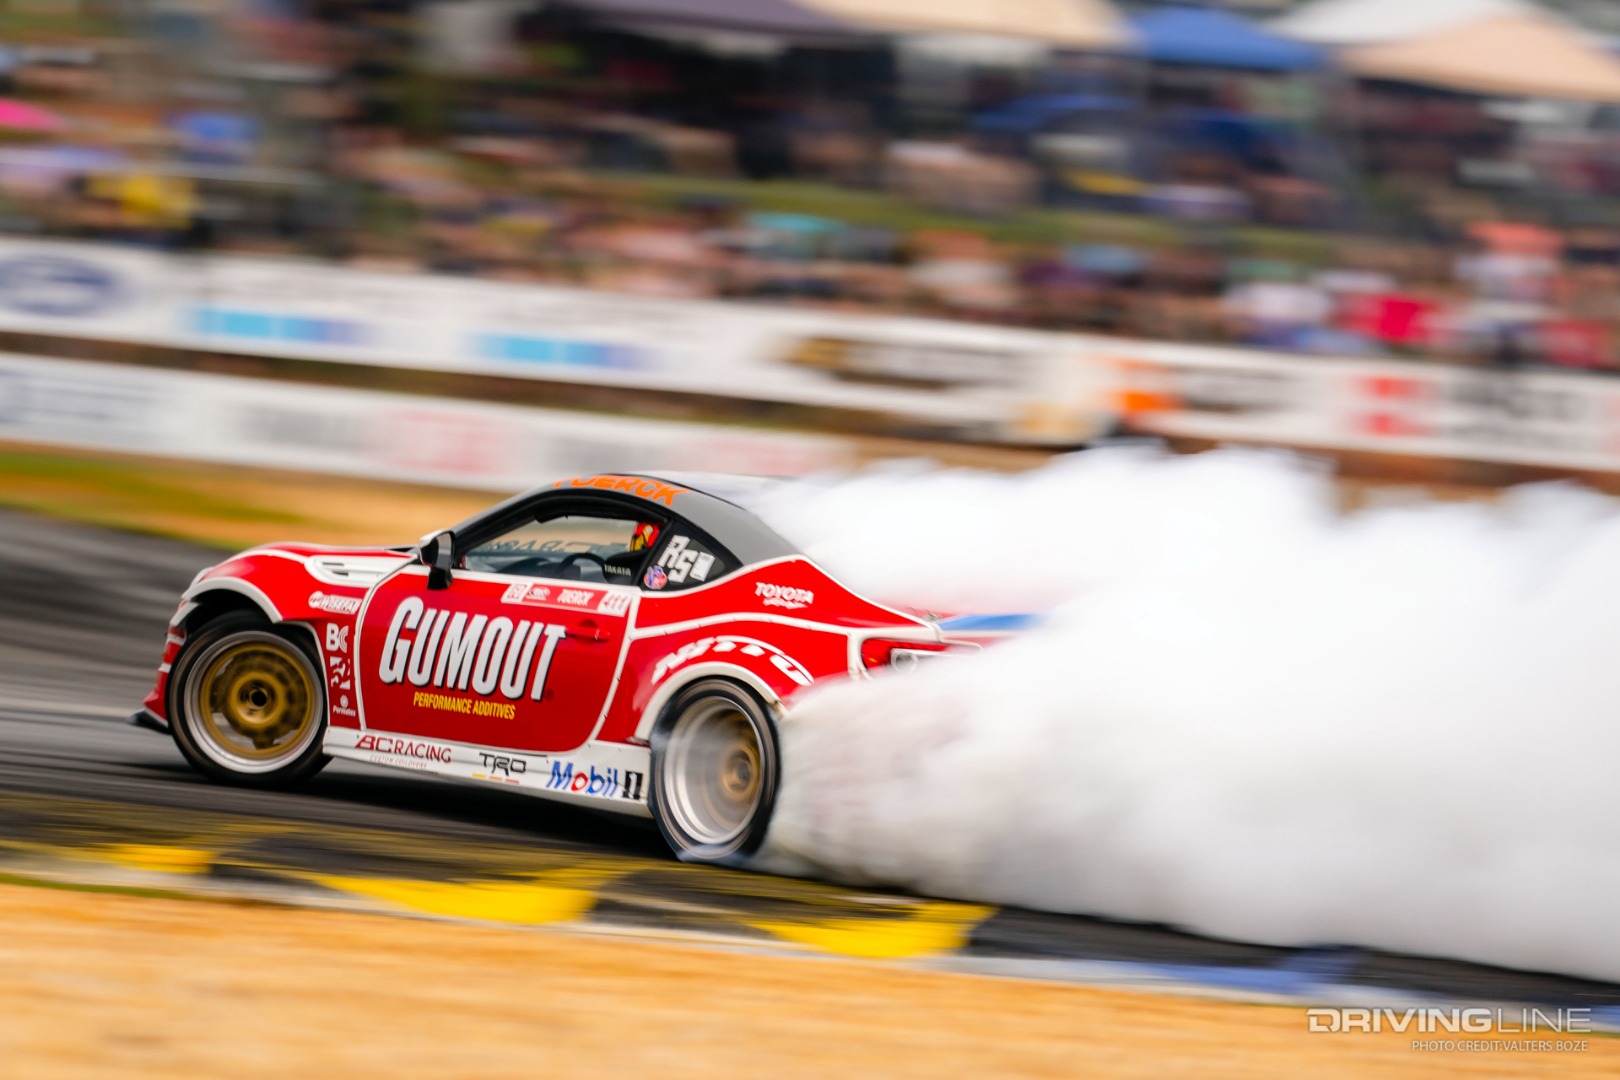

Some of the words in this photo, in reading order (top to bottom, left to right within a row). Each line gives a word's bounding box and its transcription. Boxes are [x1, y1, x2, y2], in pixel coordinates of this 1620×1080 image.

[604, 564, 631, 576] TAKATA
[755, 581, 814, 604] TOYOTA
[379, 596, 567, 701] GUMOUT
[413, 691, 473, 714] PERFORMANCE
[472, 700, 516, 720] ADDITIVES
[394, 737, 452, 764] RACING
[479, 752, 527, 776] TRD
[546, 760, 618, 797] Mobil
